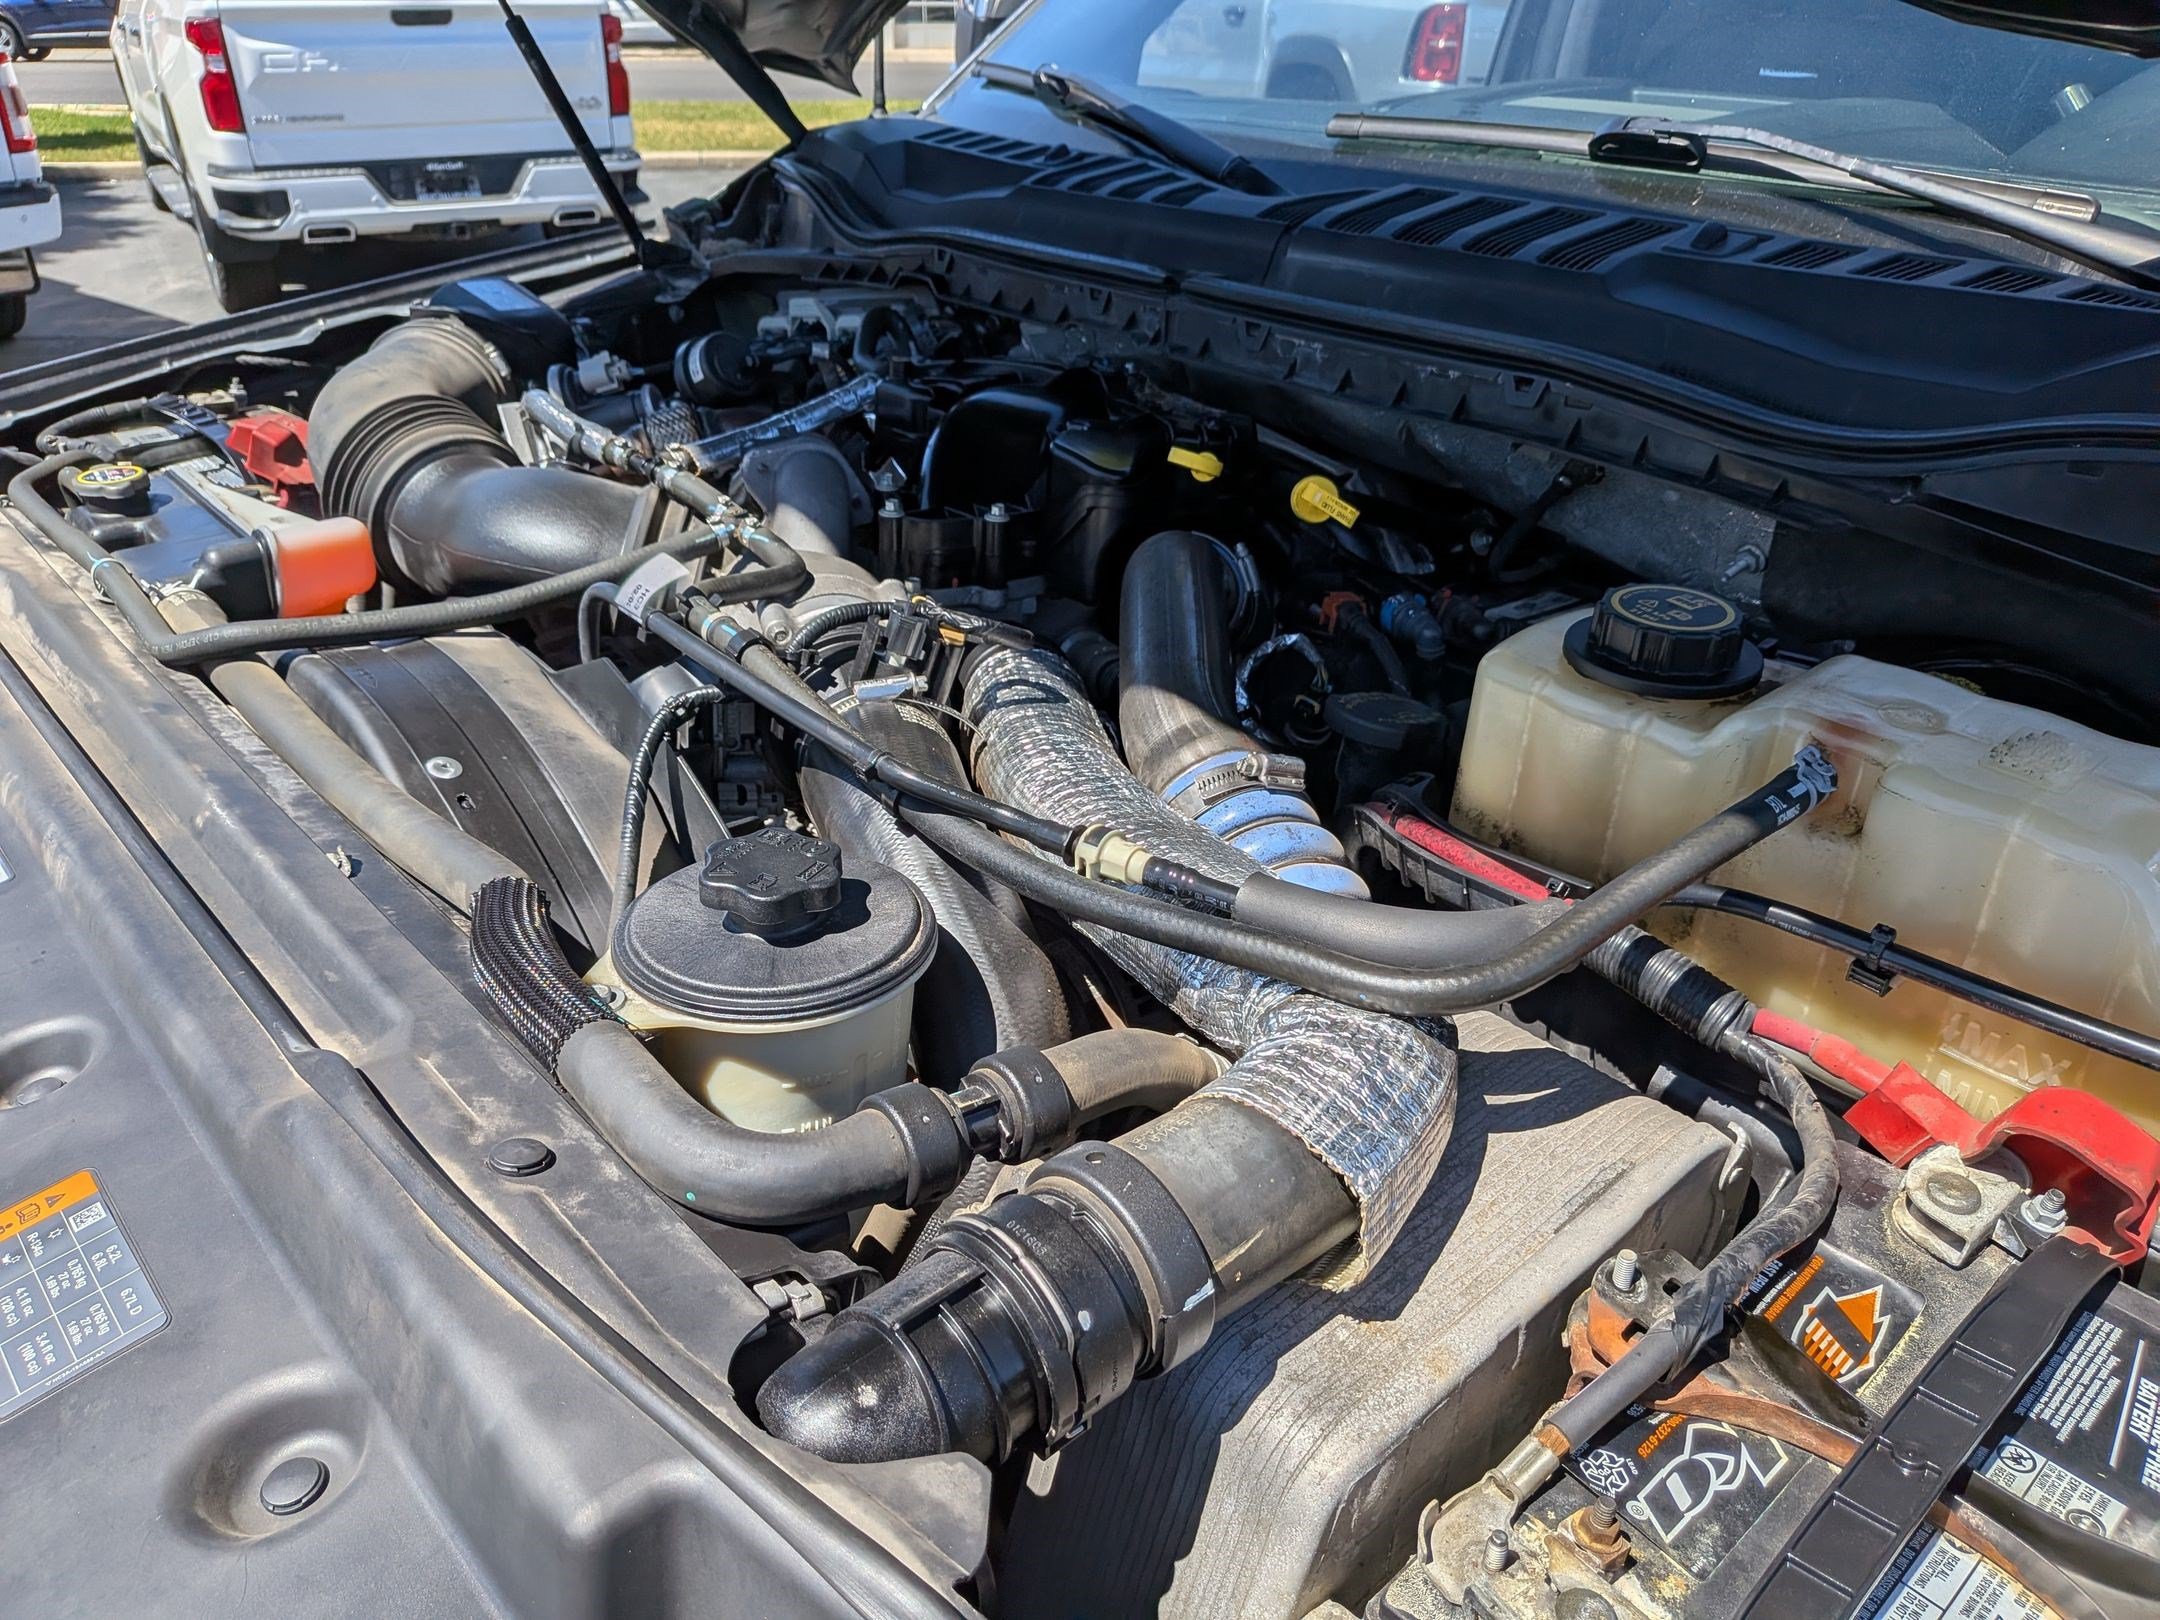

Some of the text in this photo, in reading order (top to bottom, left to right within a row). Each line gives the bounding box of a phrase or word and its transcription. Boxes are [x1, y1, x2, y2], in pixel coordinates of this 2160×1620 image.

[1970, 1027, 2072, 1087] MAX
[800, 1116, 832, 1133] MIN
[28, 1232, 44, 1256] R-134a
[106, 1244, 124, 1263] 6.2L
[67, 1259, 88, 1288] 0.765 kg
[91, 1252, 110, 1271] 6.8L
[1807, 1254, 1824, 1270] FOR
[45, 1275, 57, 1288] 1.69
[59, 1272, 70, 1288] 27 oz
[1782, 1265, 1815, 1300] NATIONWIDE
[2, 1295, 20, 1327] (120 cc)
[16, 1286, 30, 1300] 4.1
[24, 1305, 35, 1316] oz
[121, 1287, 141, 1316] 6.7L D
[1763, 1294, 1790, 1322] WARRAN
[81, 1318, 93, 1334] 27 oz
[90, 1303, 111, 1334] 0.765 kg
[66, 1321, 84, 1345] 1.69 lbs
[18, 1342, 41, 1376] (100 cc)
[36, 1332, 51, 1346] 3.4
[45, 1352, 57, 1364] oz
[2129, 1377, 2159, 1443] BATTERY
[1597, 1463, 1611, 1478] Pb
[1626, 1457, 1638, 1474] LEAD
[2033, 1463, 2056, 1490] OR INJURY.
[2053, 1469, 2067, 1482] CAN
[2002, 1471, 2017, 1486] KEEP
[2043, 1478, 2061, 1498] CAUSE
[2055, 1476, 2081, 1510] EXPLOSIVE
[2076, 1485, 2096, 1505] EYES.
[2090, 1494, 2111, 1518] SHIELD
[1893, 1554, 1909, 1570] NOT
[1901, 1546, 1915, 1559] DO
[1912, 1545, 1950, 1590] INSTRUCTIONS.
[1934, 1553, 1960, 1582] READ ALL
[1869, 1565, 1902, 1604] DISASSEMBLE
[1957, 1567, 1997, 1617] OR SEVERE BURNS.
[1994, 1575, 2010, 1590] CAN
[1862, 1598, 1877, 1612] OR
[1892, 1591, 1915, 1619] DO NOT
[1914, 1599, 1928, 1612] DO
[1983, 1586, 2003, 1608] CAUSE
[2012, 1588, 2032, 1608] ACID
